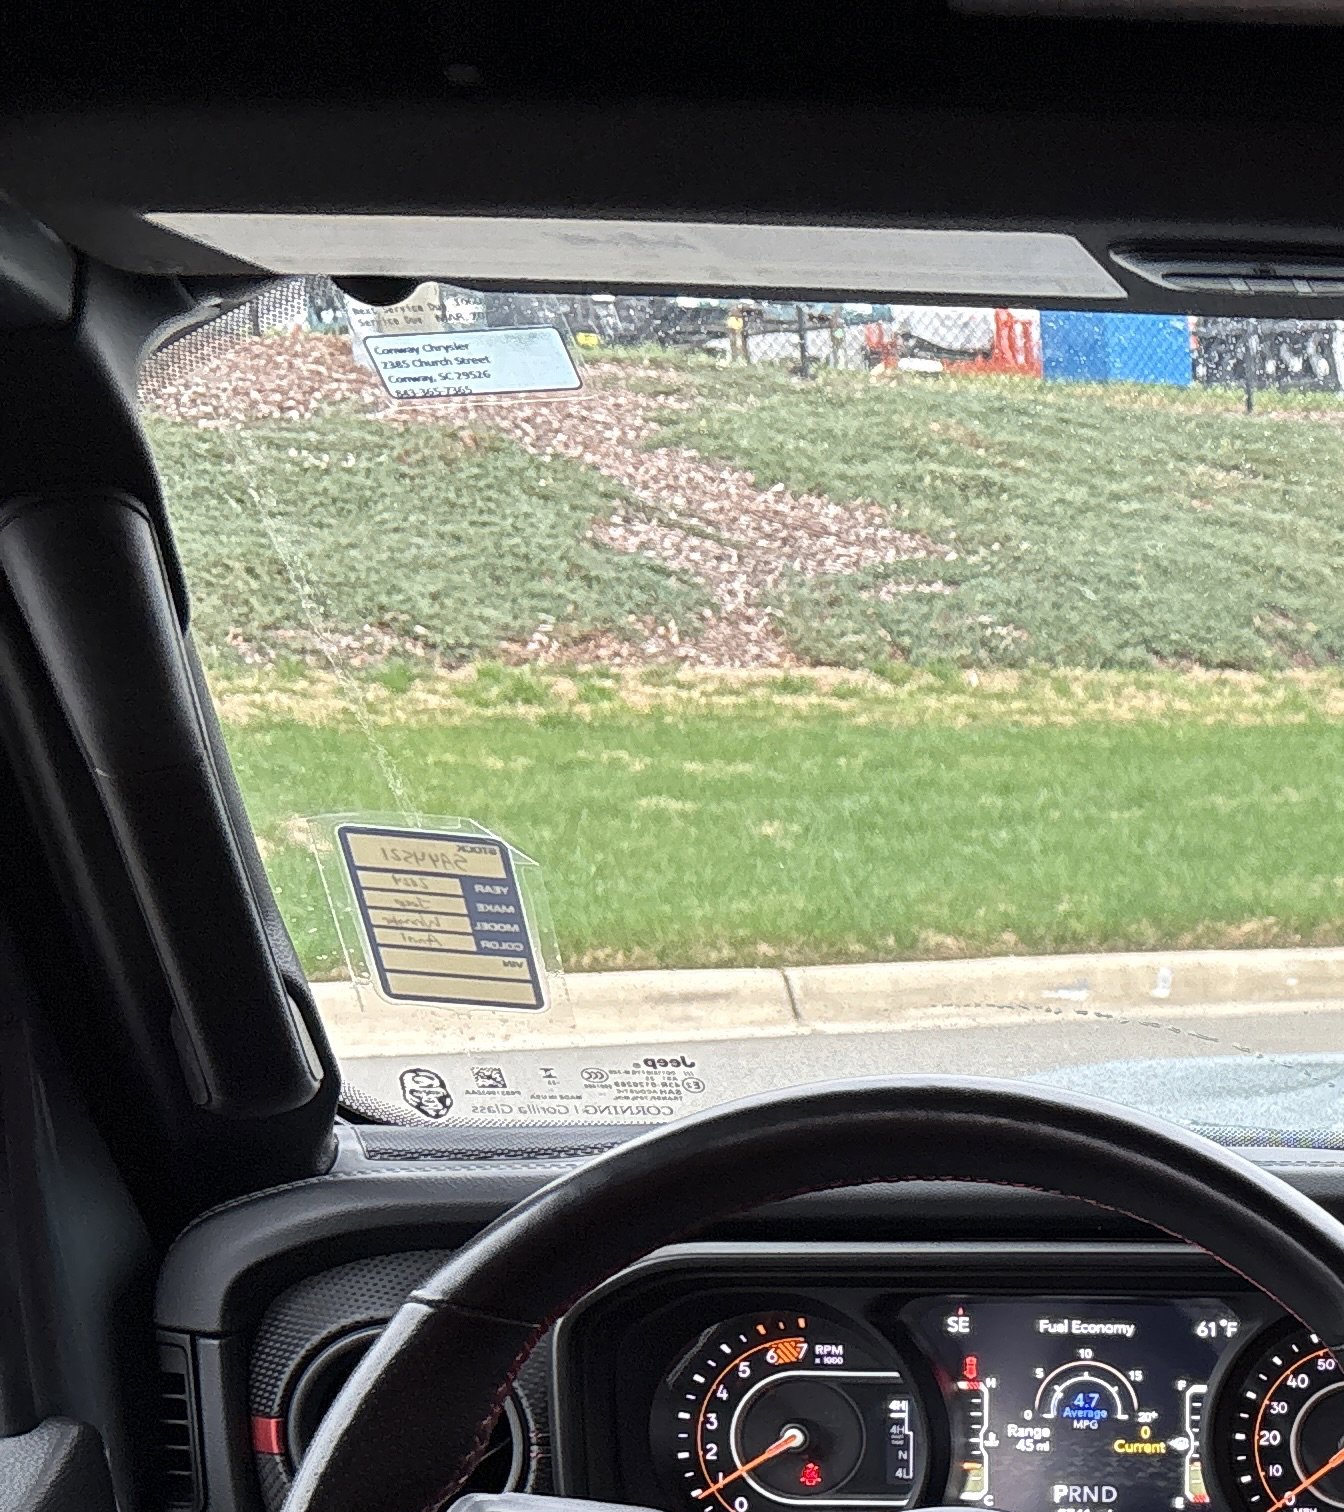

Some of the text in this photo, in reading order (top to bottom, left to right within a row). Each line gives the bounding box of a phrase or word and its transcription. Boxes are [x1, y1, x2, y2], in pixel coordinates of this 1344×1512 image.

[374, 342, 470, 356] Conway Chrysler
[412, 356, 453, 368] Church
[457, 355, 491, 366] Street
[438, 372, 454, 382] SC
[456, 370, 492, 380] 29526
[946, 1316, 971, 1333] SE
[1038, 1319, 1136, 1337] Fuel Economy
[1196, 1319, 1239, 1338] 61°F
[814, 1344, 844, 1356] RPM
[1078, 1348, 1093, 1360] 10
[737, 1361, 751, 1378] 5
[1316, 1358, 1336, 1372] 50
[1129, 1370, 1143, 1382] 15
[1286, 1373, 1309, 1389] 40
[716, 1384, 729, 1401] 4
[888, 1400, 907, 1412] 4H
[1072, 1392, 1101, 1409] 4.7
[1062, 1407, 1108, 1421] Average
[1269, 1401, 1288, 1415] 30
[705, 1413, 718, 1430] 3
[1072, 1419, 1099, 1430] MPG
[889, 1424, 906, 1435] 4H
[1007, 1424, 1051, 1442] Range
[1259, 1430, 1281, 1446] 20
[705, 1443, 718, 1460] 2
[1015, 1440, 1051, 1453] 45 mi
[1113, 1440, 1167, 1455] Current
[1268, 1464, 1283, 1478] 10
[734, 1496, 749, 1512] 0
